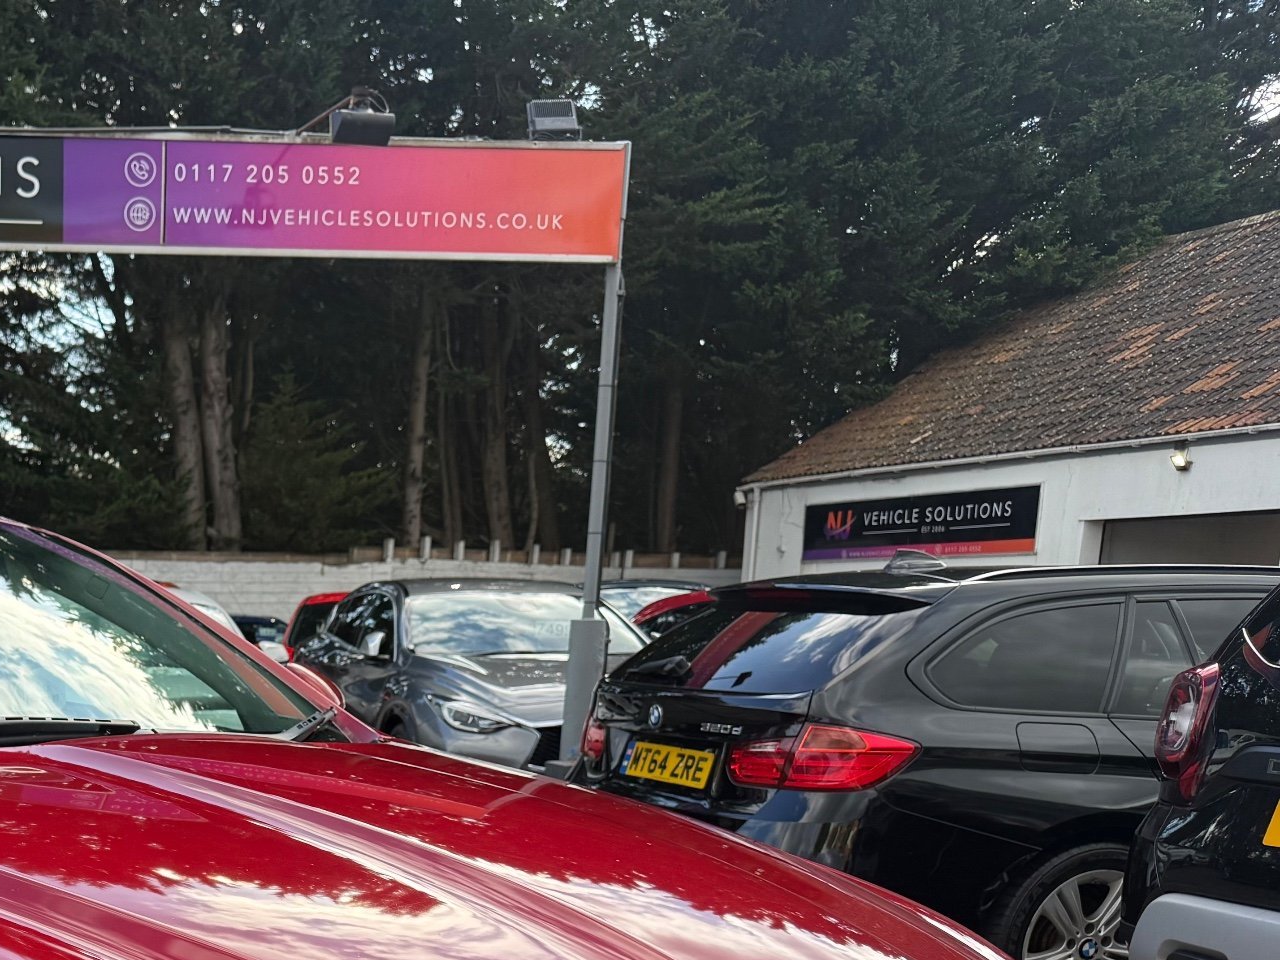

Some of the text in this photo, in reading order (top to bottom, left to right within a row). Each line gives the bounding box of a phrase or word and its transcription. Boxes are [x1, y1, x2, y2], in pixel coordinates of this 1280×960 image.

[174, 162, 361, 186] 0117 205 0552
[173, 206, 565, 231] WWW.NJVEHICLESOLUTIONS.CO.UK
[863, 500, 1013, 527] VEHICLE SOLUTIONS
[670, 752, 709, 783] ZRE
